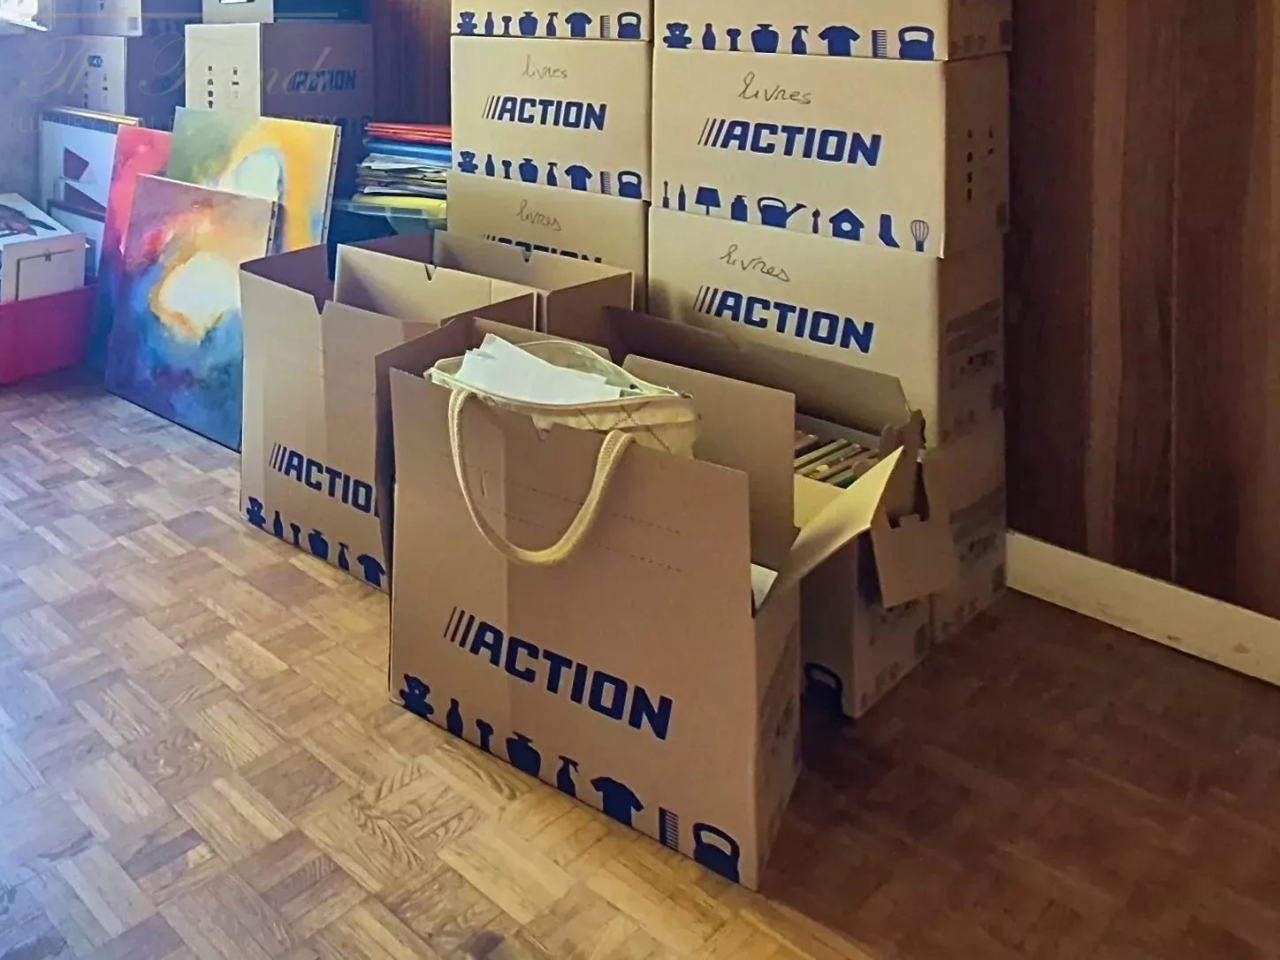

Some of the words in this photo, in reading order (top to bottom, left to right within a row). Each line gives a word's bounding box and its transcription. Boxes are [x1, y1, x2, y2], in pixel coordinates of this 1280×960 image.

[497, 96, 608, 131] ACTION
[720, 120, 882, 167] ACTION
[714, 290, 875, 354] ACTION
[284, 450, 380, 518] ACTIO
[470, 621, 673, 741] ACTION
